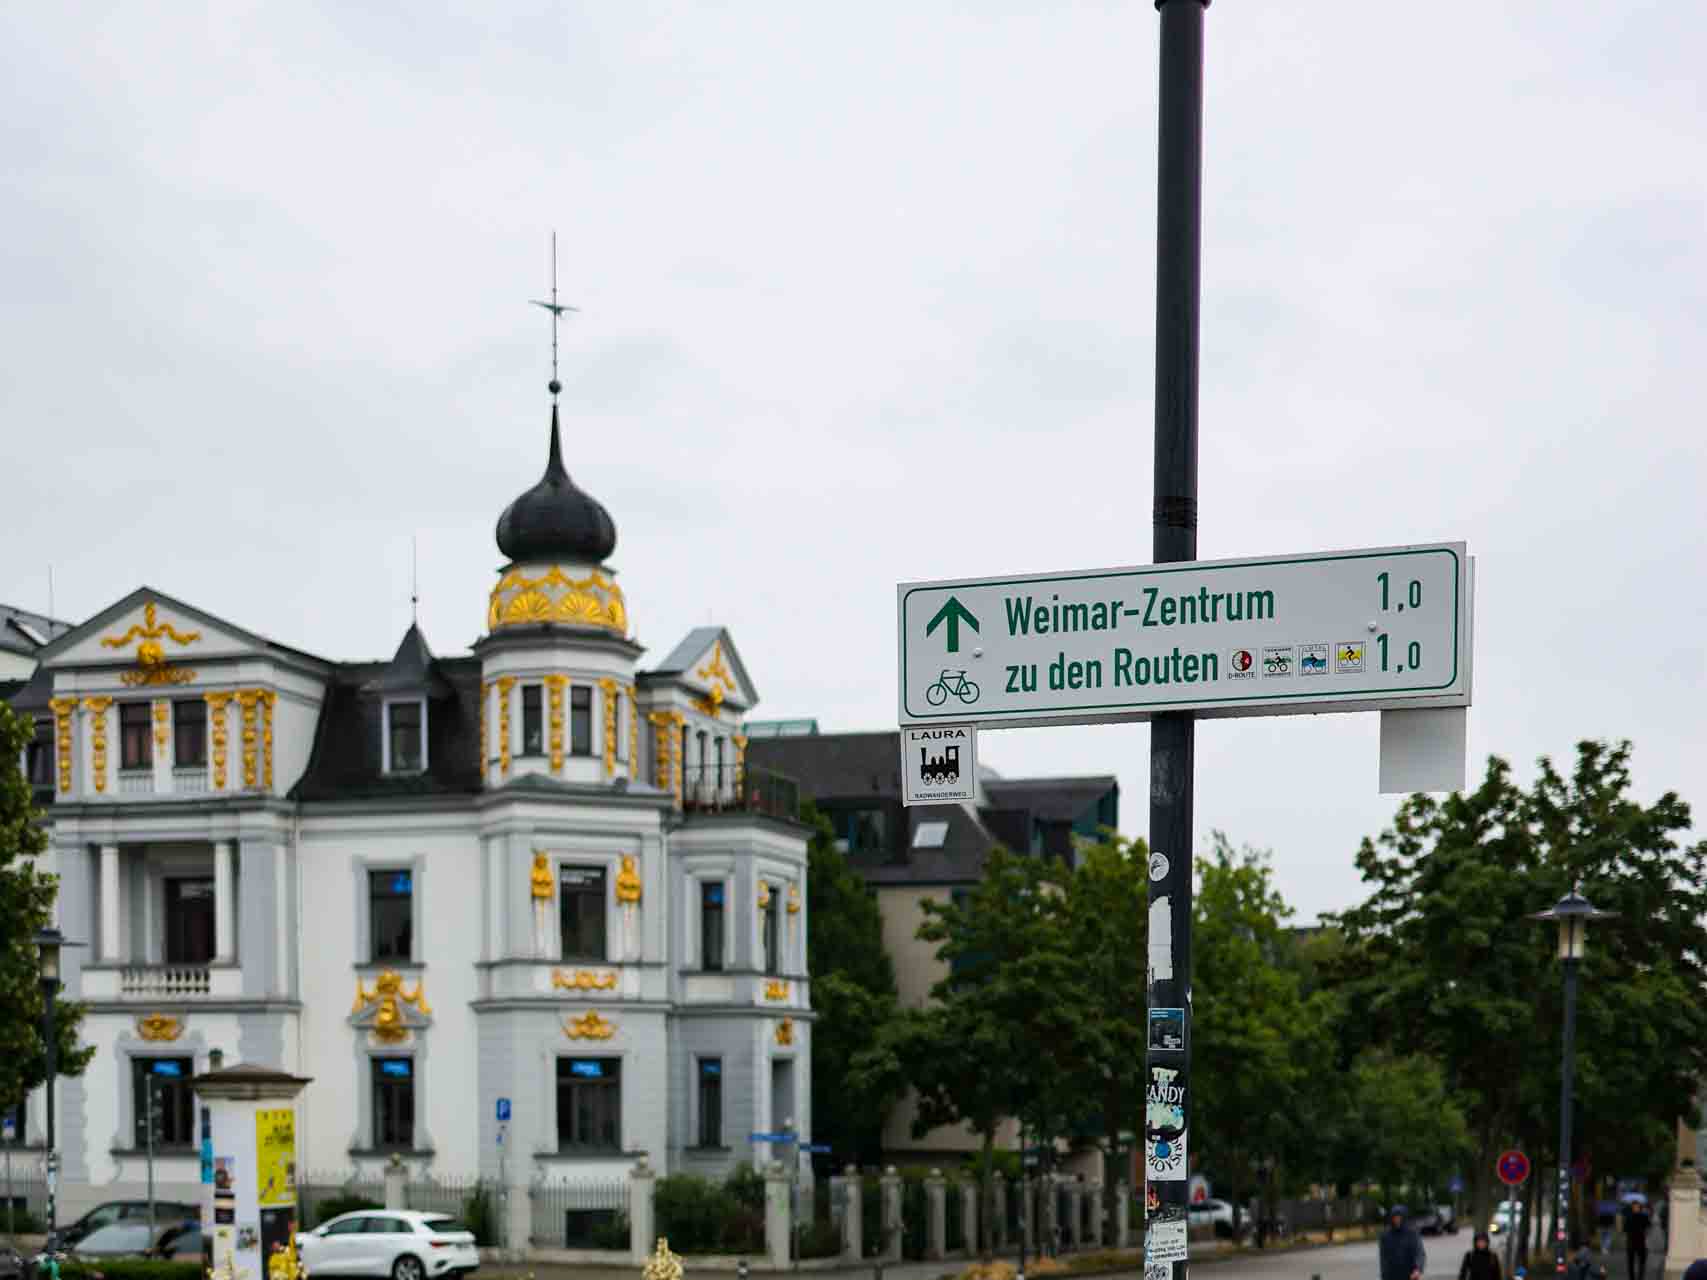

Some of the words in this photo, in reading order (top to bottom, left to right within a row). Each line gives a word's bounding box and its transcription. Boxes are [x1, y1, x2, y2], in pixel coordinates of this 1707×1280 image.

[1005, 587, 1275, 636] Weimar-Zentrum
[1377, 571, 1421, 612] 1,0
[1005, 664, 1037, 693] zu
[1050, 652, 1102, 691] den
[1114, 647, 1219, 687] Routen
[1377, 633, 1420, 673] 1,0
[911, 729, 966, 741] LAURA
